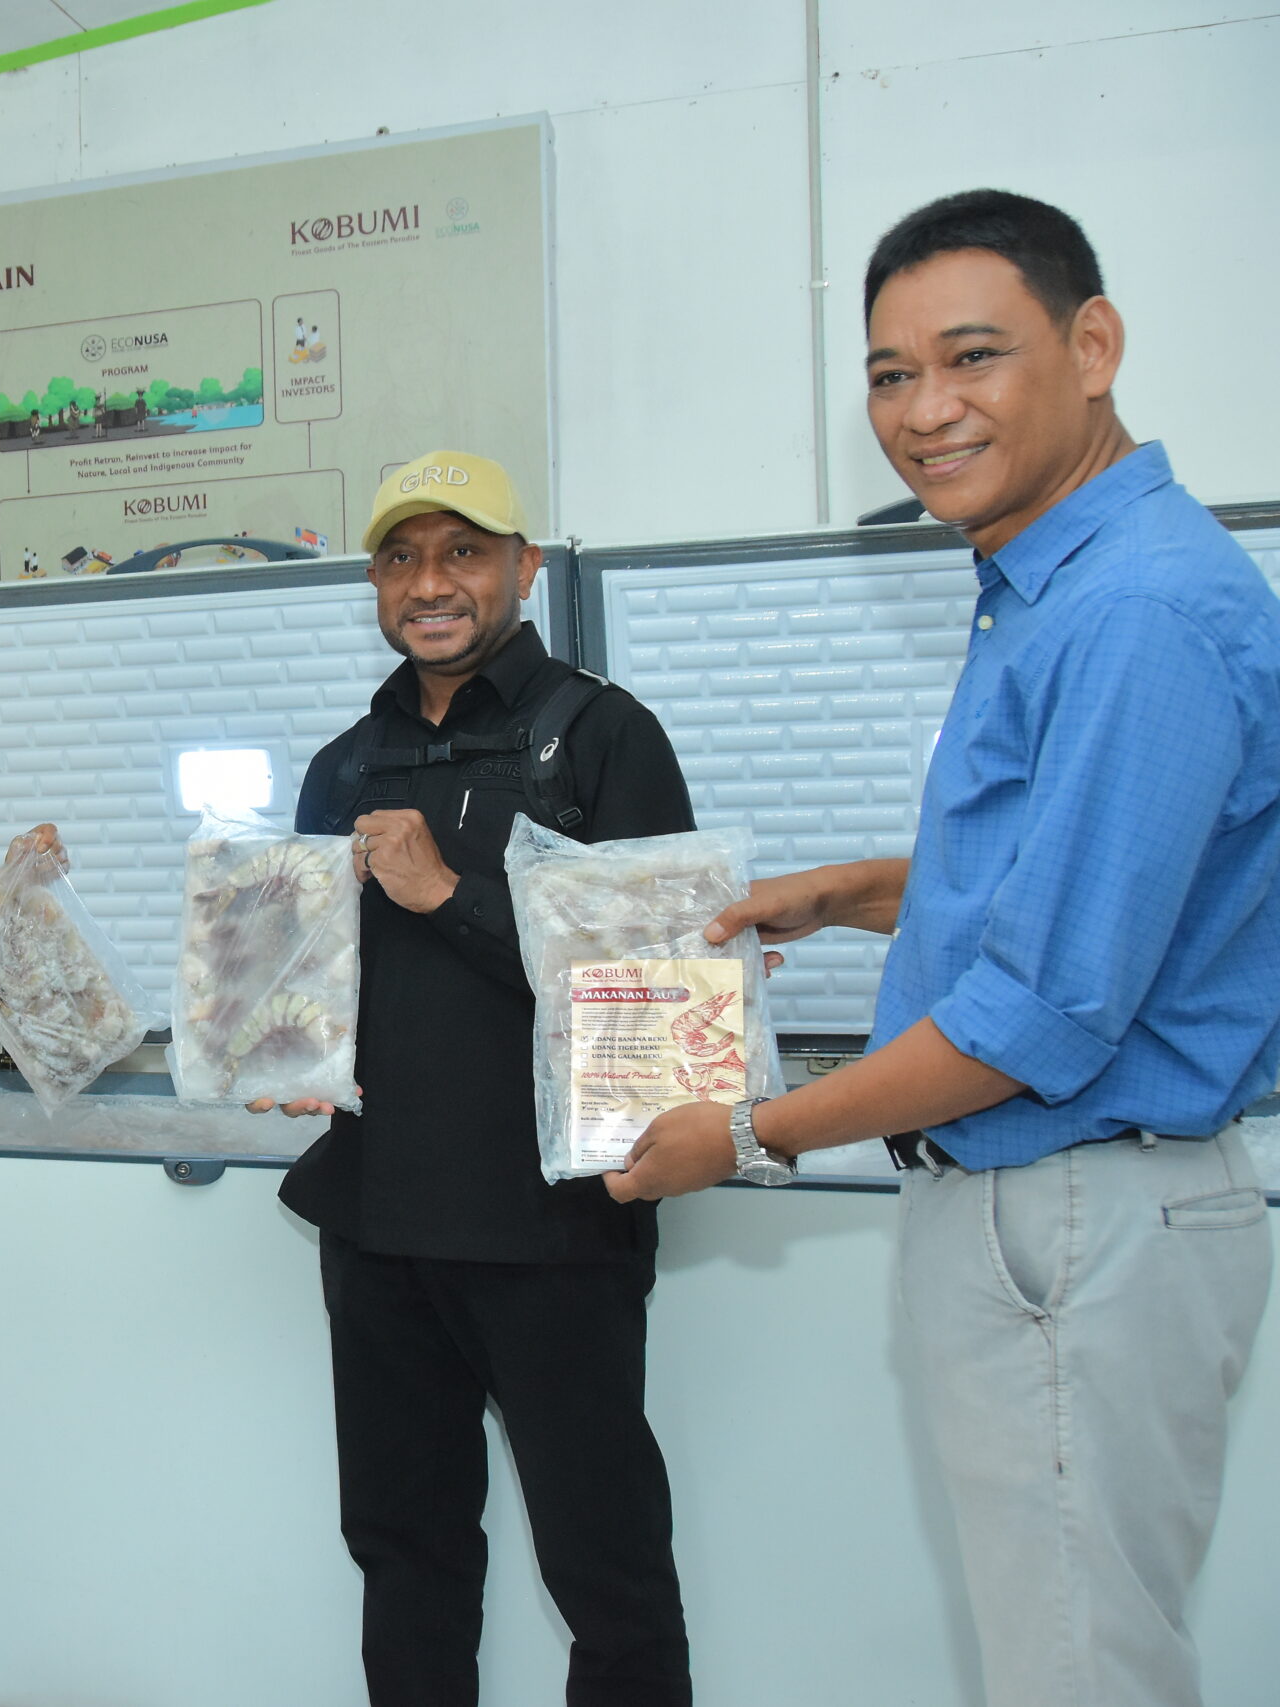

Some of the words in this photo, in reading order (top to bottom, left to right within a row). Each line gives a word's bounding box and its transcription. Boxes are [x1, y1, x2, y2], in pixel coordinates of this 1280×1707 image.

[290, 204, 420, 244] KOBUMI
[111, 332, 168, 350] ECONUSA
[101, 364, 149, 377] PROGRAM
[291, 374, 326, 386] IMPACT
[282, 384, 336, 397] INVESTORS
[69, 458, 91, 467] Profit
[125, 452, 160, 462] Reinvest
[162, 450, 171, 458] to
[240, 442, 252, 450] for
[109, 466, 131, 476] Local
[133, 464, 148, 473] and
[150, 461, 195, 473] Indigenous
[197, 456, 245, 468] Community
[399, 464, 470, 493] GRD
[123, 493, 208, 516] KOBUMI
[582, 967, 643, 979] KOBUMI
[580, 990, 644, 1000] MAKANAN
[600, 1071, 631, 1080] Natural
[631, 1071, 663, 1080] Product
